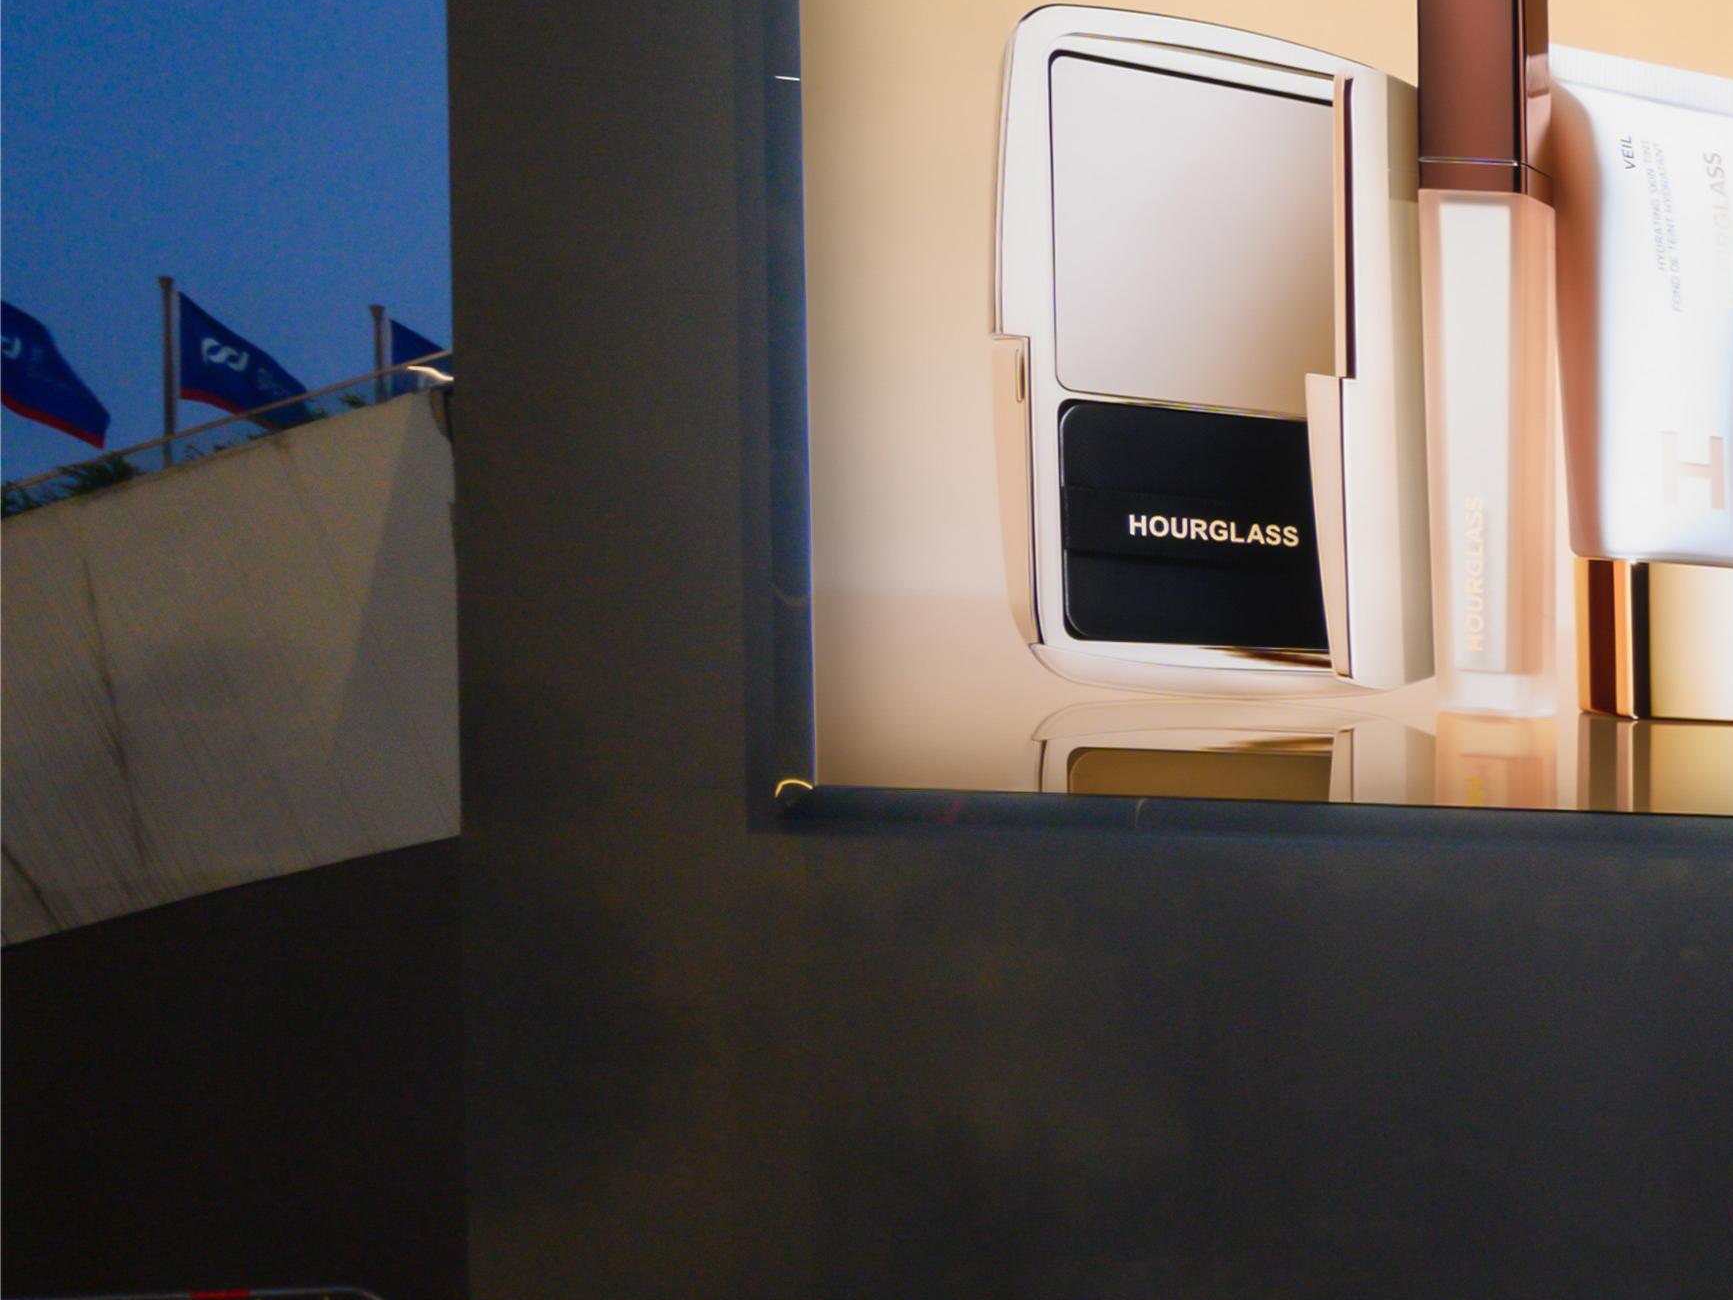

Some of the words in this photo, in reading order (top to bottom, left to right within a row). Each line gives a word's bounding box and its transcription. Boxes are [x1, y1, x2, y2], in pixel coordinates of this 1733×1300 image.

[1620, 135, 1636, 169] VEIL
[1128, 514, 1299, 547] HOURGLASS
[1464, 494, 1486, 652] HOURGLASS
